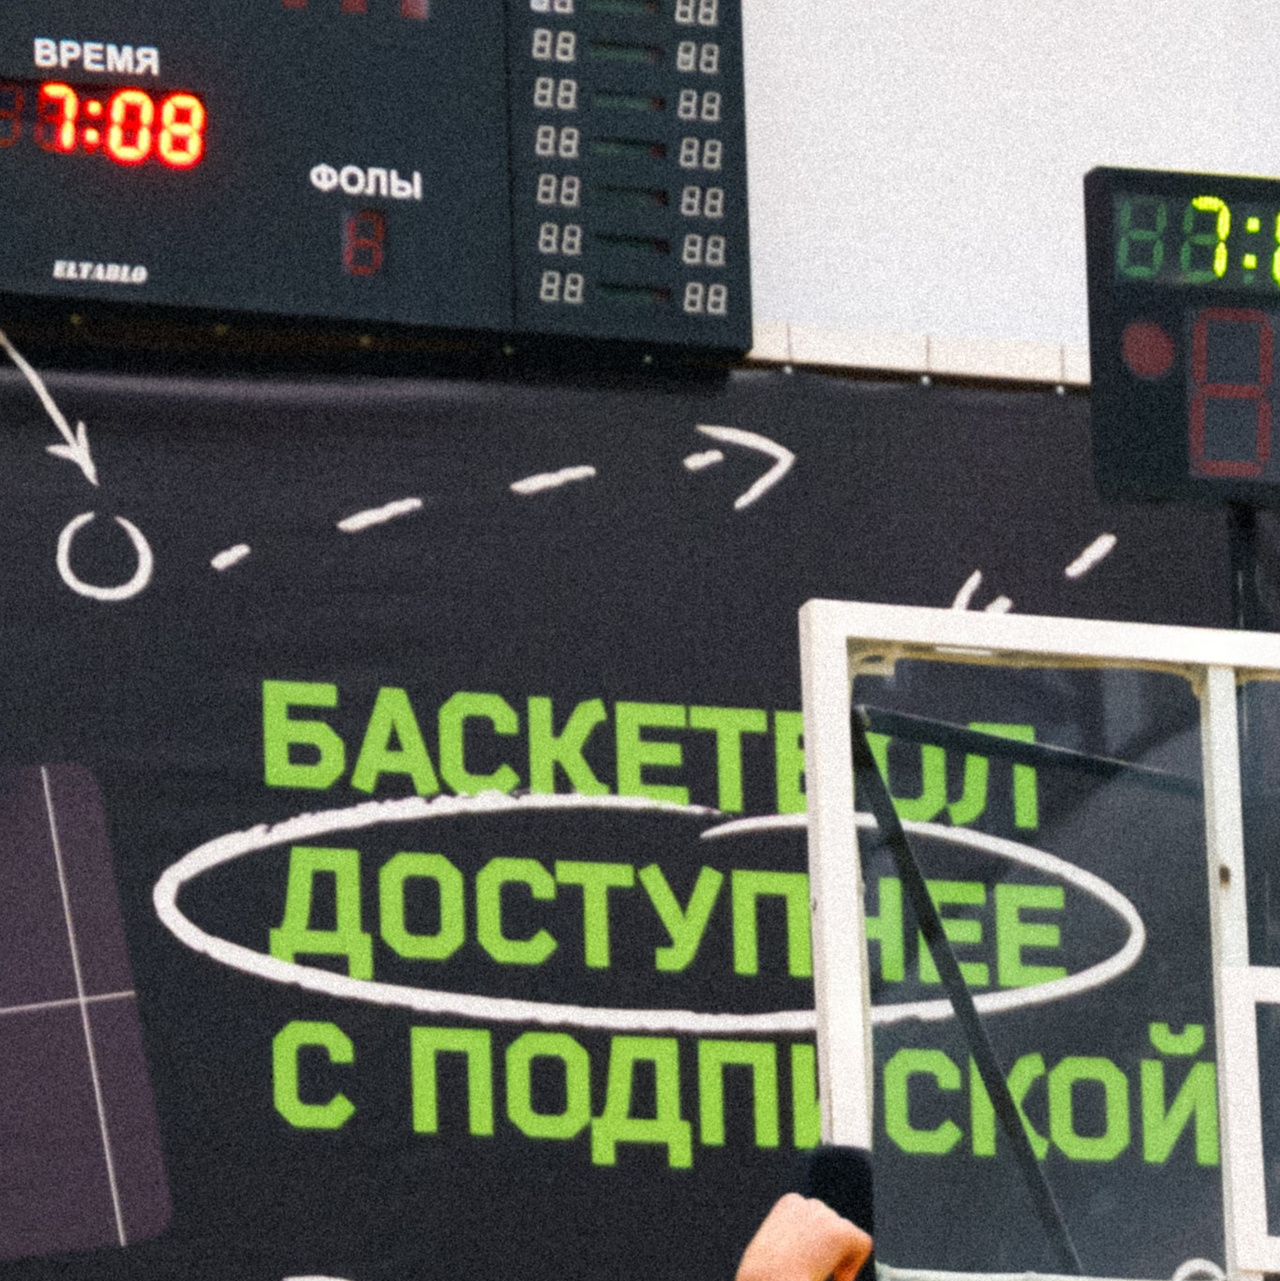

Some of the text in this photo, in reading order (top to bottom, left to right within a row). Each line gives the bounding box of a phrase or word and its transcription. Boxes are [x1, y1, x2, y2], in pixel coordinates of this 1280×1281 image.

[34, 37, 160, 76] ВРЕМЯ
[40, 82, 207, 169] 7:08
[310, 163, 423, 200] ФОЛЫ
[271, 1020, 356, 1130] С
